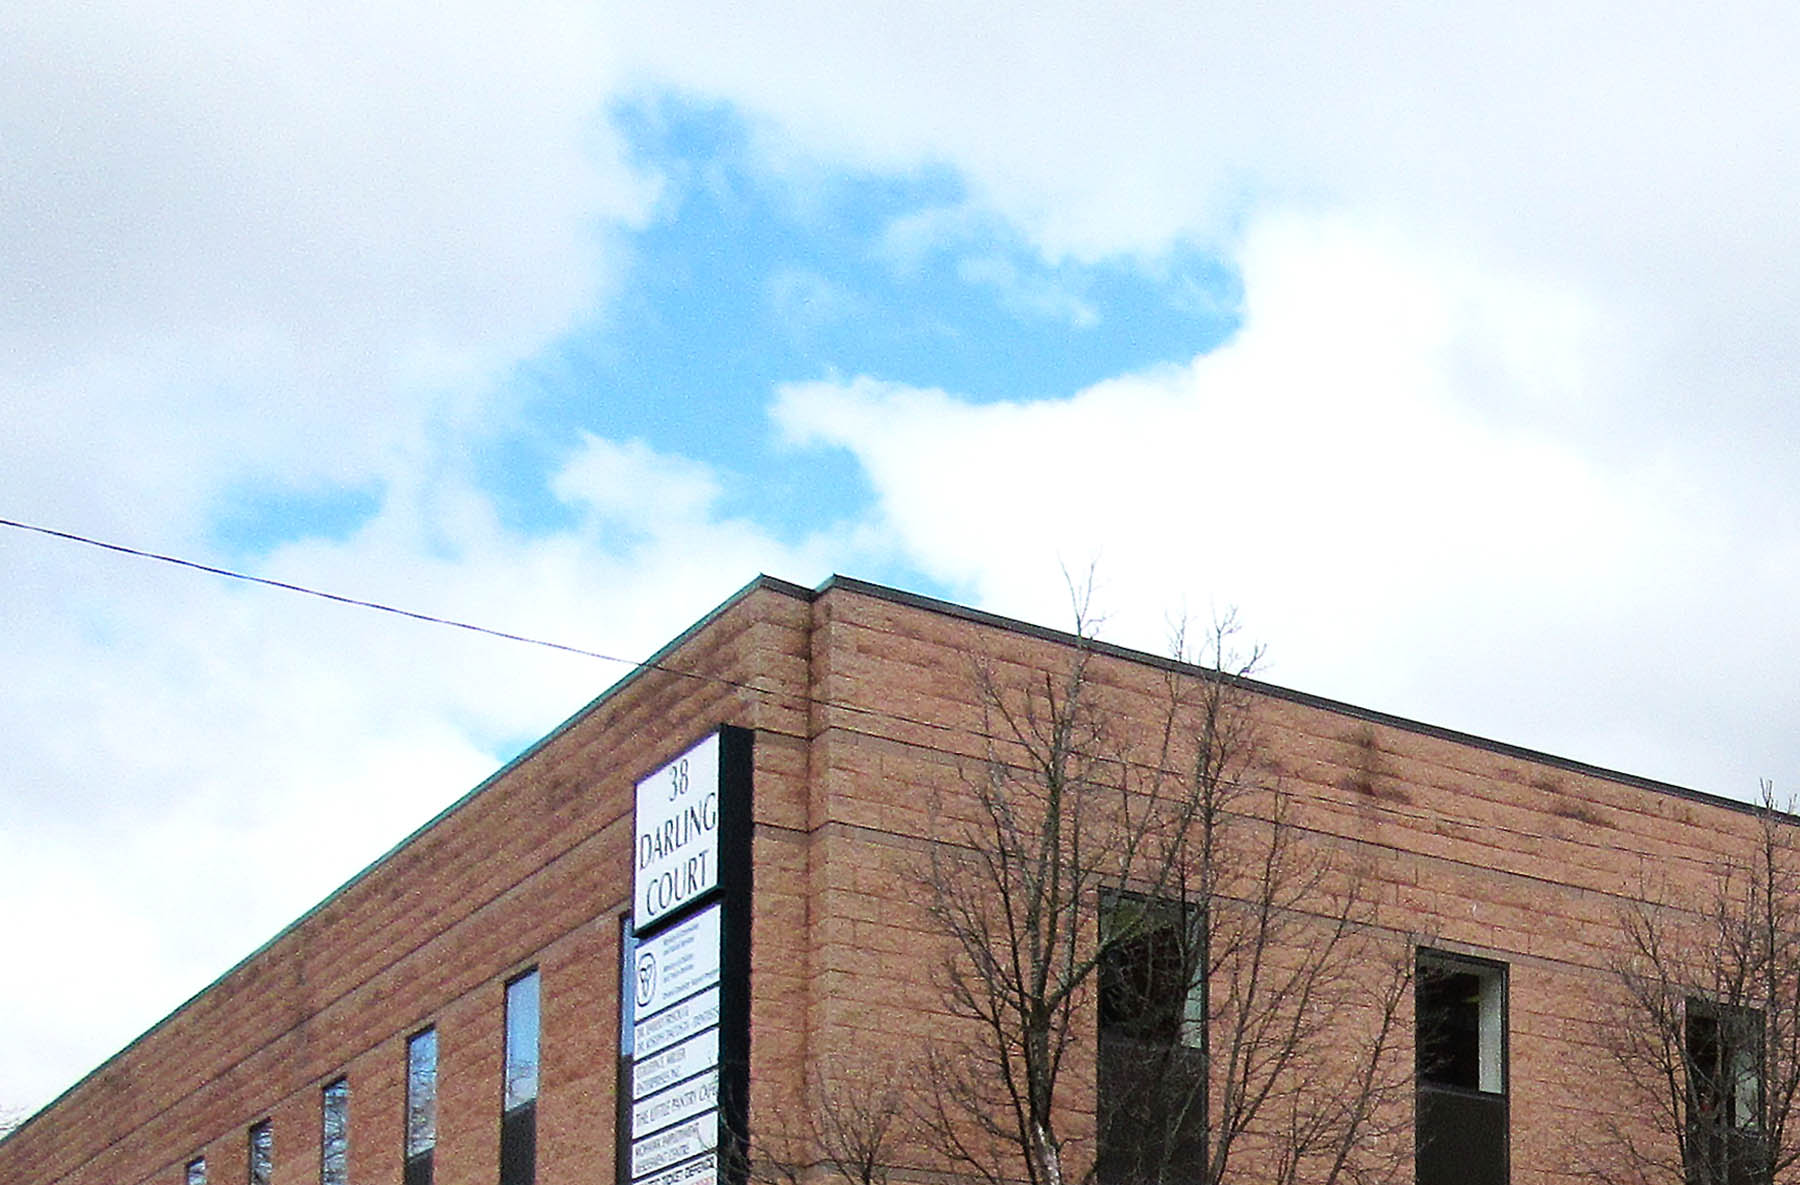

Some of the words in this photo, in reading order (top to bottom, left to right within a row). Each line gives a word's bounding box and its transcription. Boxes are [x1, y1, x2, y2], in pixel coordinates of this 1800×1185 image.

[668, 758, 689, 802] 38
[640, 792, 716, 870] DARLING
[646, 849, 710, 916] COURT
